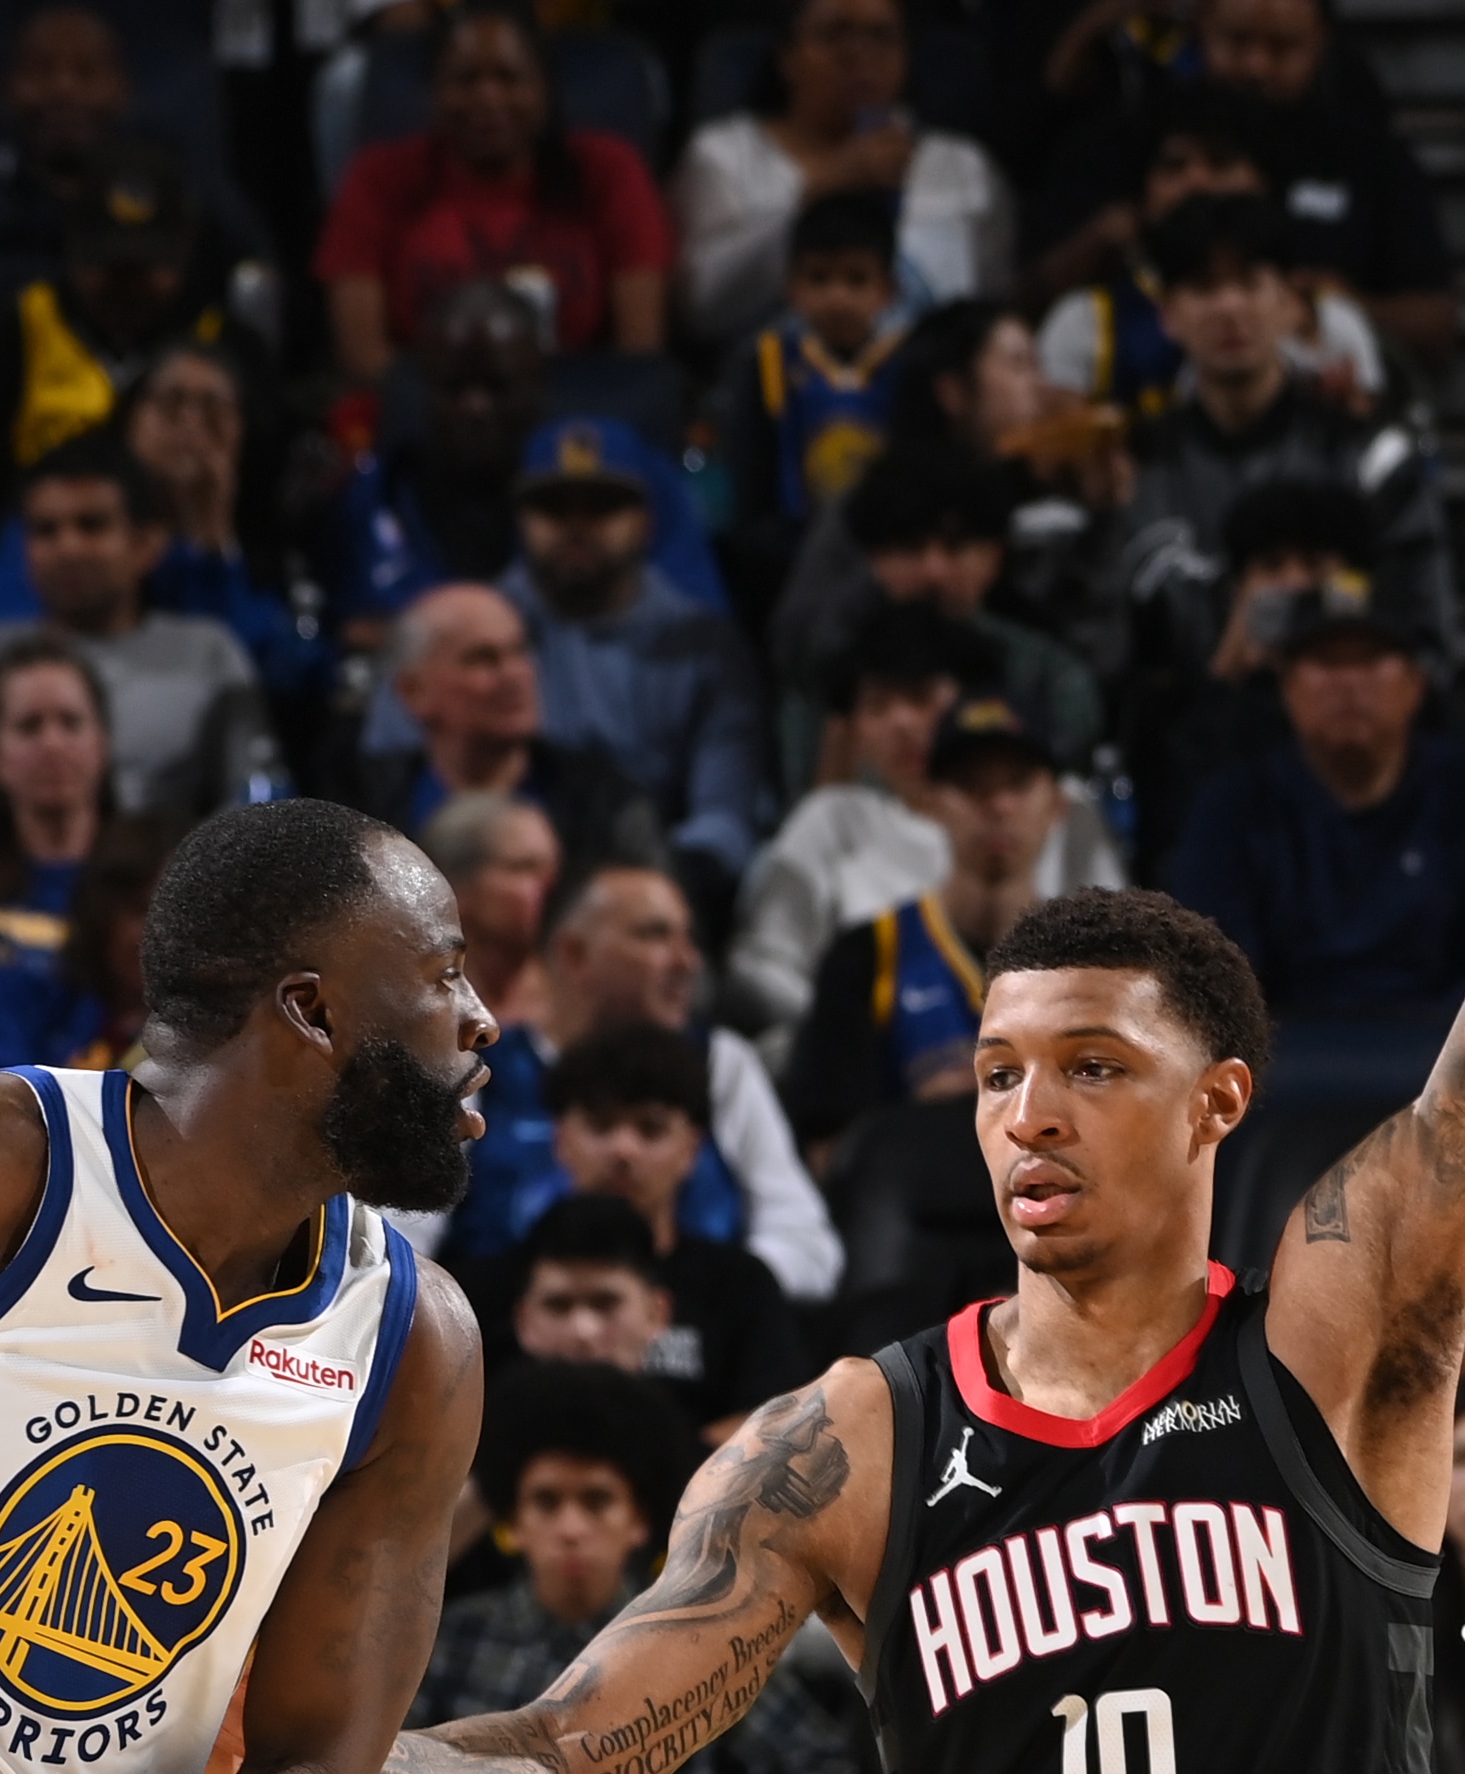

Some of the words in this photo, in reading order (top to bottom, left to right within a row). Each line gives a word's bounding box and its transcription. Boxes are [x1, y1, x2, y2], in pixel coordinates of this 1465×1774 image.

[248, 1339, 355, 1392] Rakuten
[26, 1392, 196, 1445] GOLDEN
[203, 1424, 275, 1538] STATE
[118, 1520, 230, 1606] 23
[909, 1500, 1303, 1717] HOUSTON
[581, 1661, 730, 1763] Complacency
[729, 1600, 797, 1674] Breeds
[718, 1666, 762, 1722] And
